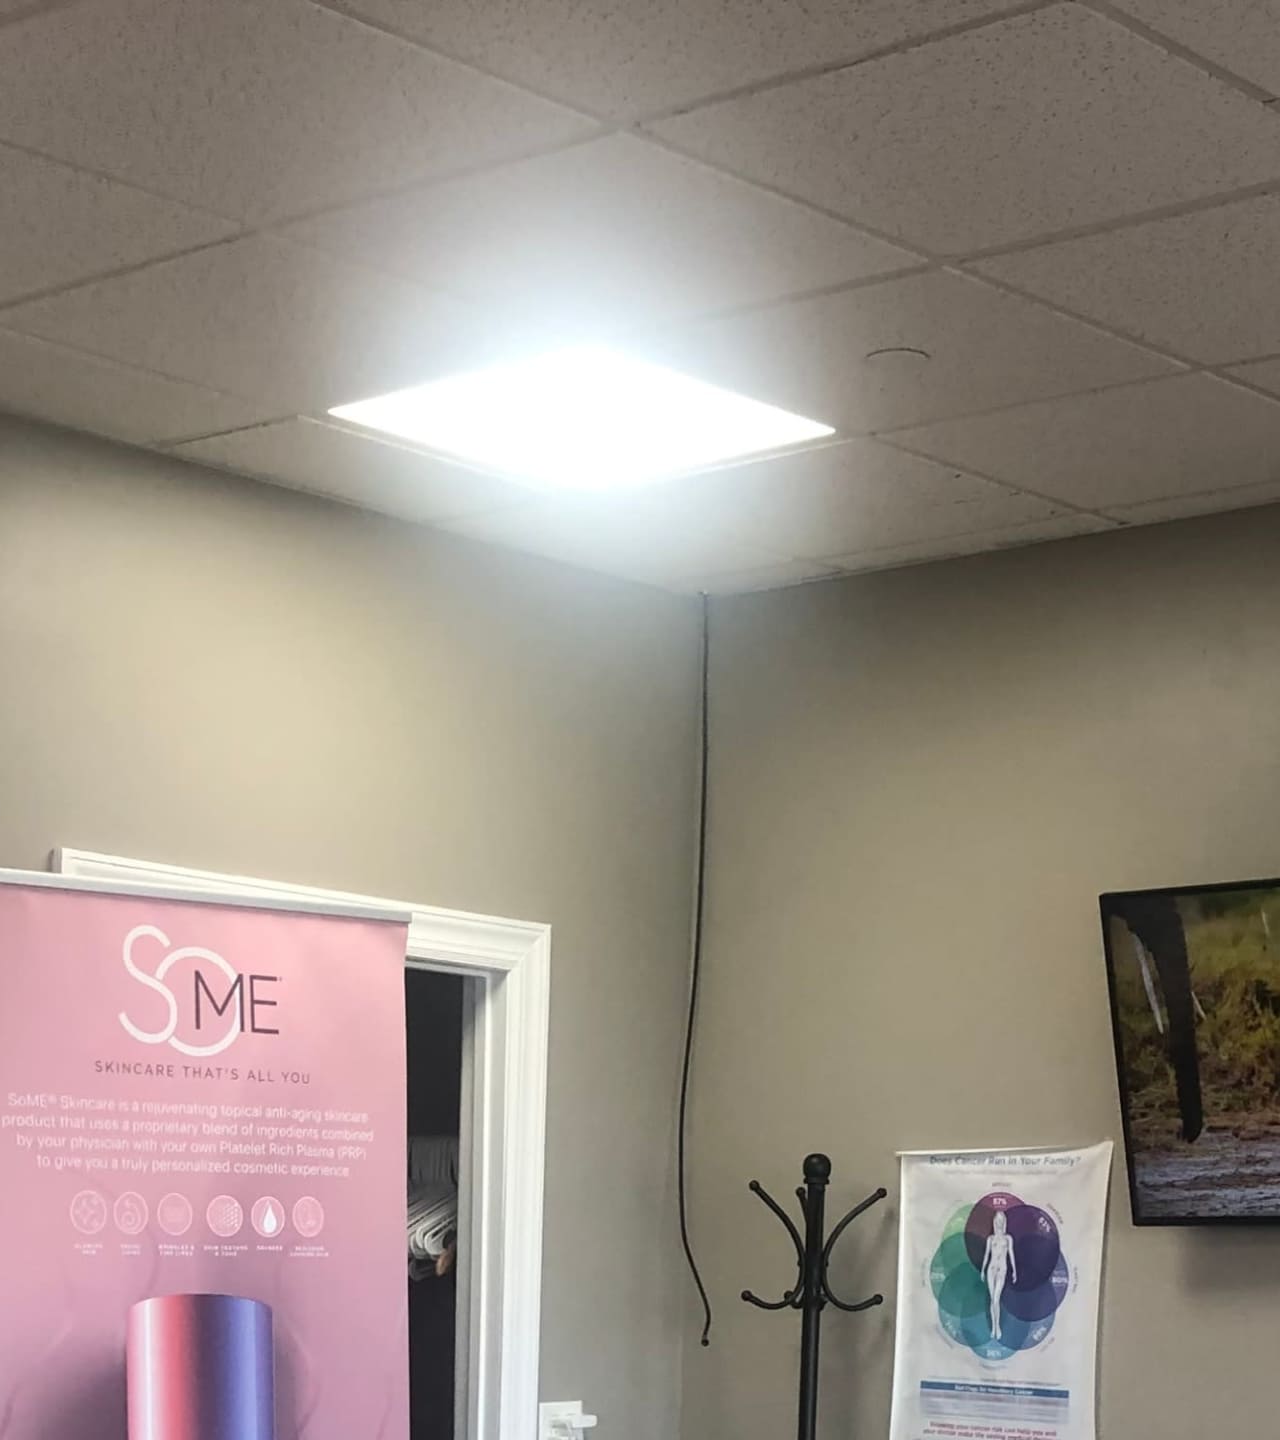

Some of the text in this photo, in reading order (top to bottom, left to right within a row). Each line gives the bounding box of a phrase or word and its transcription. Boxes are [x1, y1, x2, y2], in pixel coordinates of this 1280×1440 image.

[95, 1060, 311, 1085] SKINCARE THAT'S ALL YOU
[60, 1095, 116, 1112] Skincare
[118, 1100, 129, 1112] is
[142, 1101, 217, 1119] rejuvenating
[220, 1104, 263, 1119] topical
[265, 1106, 322, 1123] anti-aging
[324, 1109, 369, 1123] skincare
[1, 1113, 56, 1129] product
[60, 1115, 86, 1129] that
[89, 1119, 120, 1131] uses
[132, 1120, 199, 1137] proprietary
[202, 1122, 238, 1137] blend
[241, 1123, 253, 1137] of
[257, 1125, 320, 1141] ingredients
[321, 1128, 375, 1142] combined
[17, 1133, 367, 1161] by your physician with your own Platelet Rich Plasma (PRP)
[36, 1154, 51, 1169] to
[54, 1155, 81, 1171] give
[85, 1158, 108, 1172] you
[122, 1157, 148, 1173] truly
[151, 1159, 230, 1174] personalized
[233, 1161, 289, 1176] cosmetic
[929, 1155, 1081, 1167] Does Cancer Run in Your Family?
